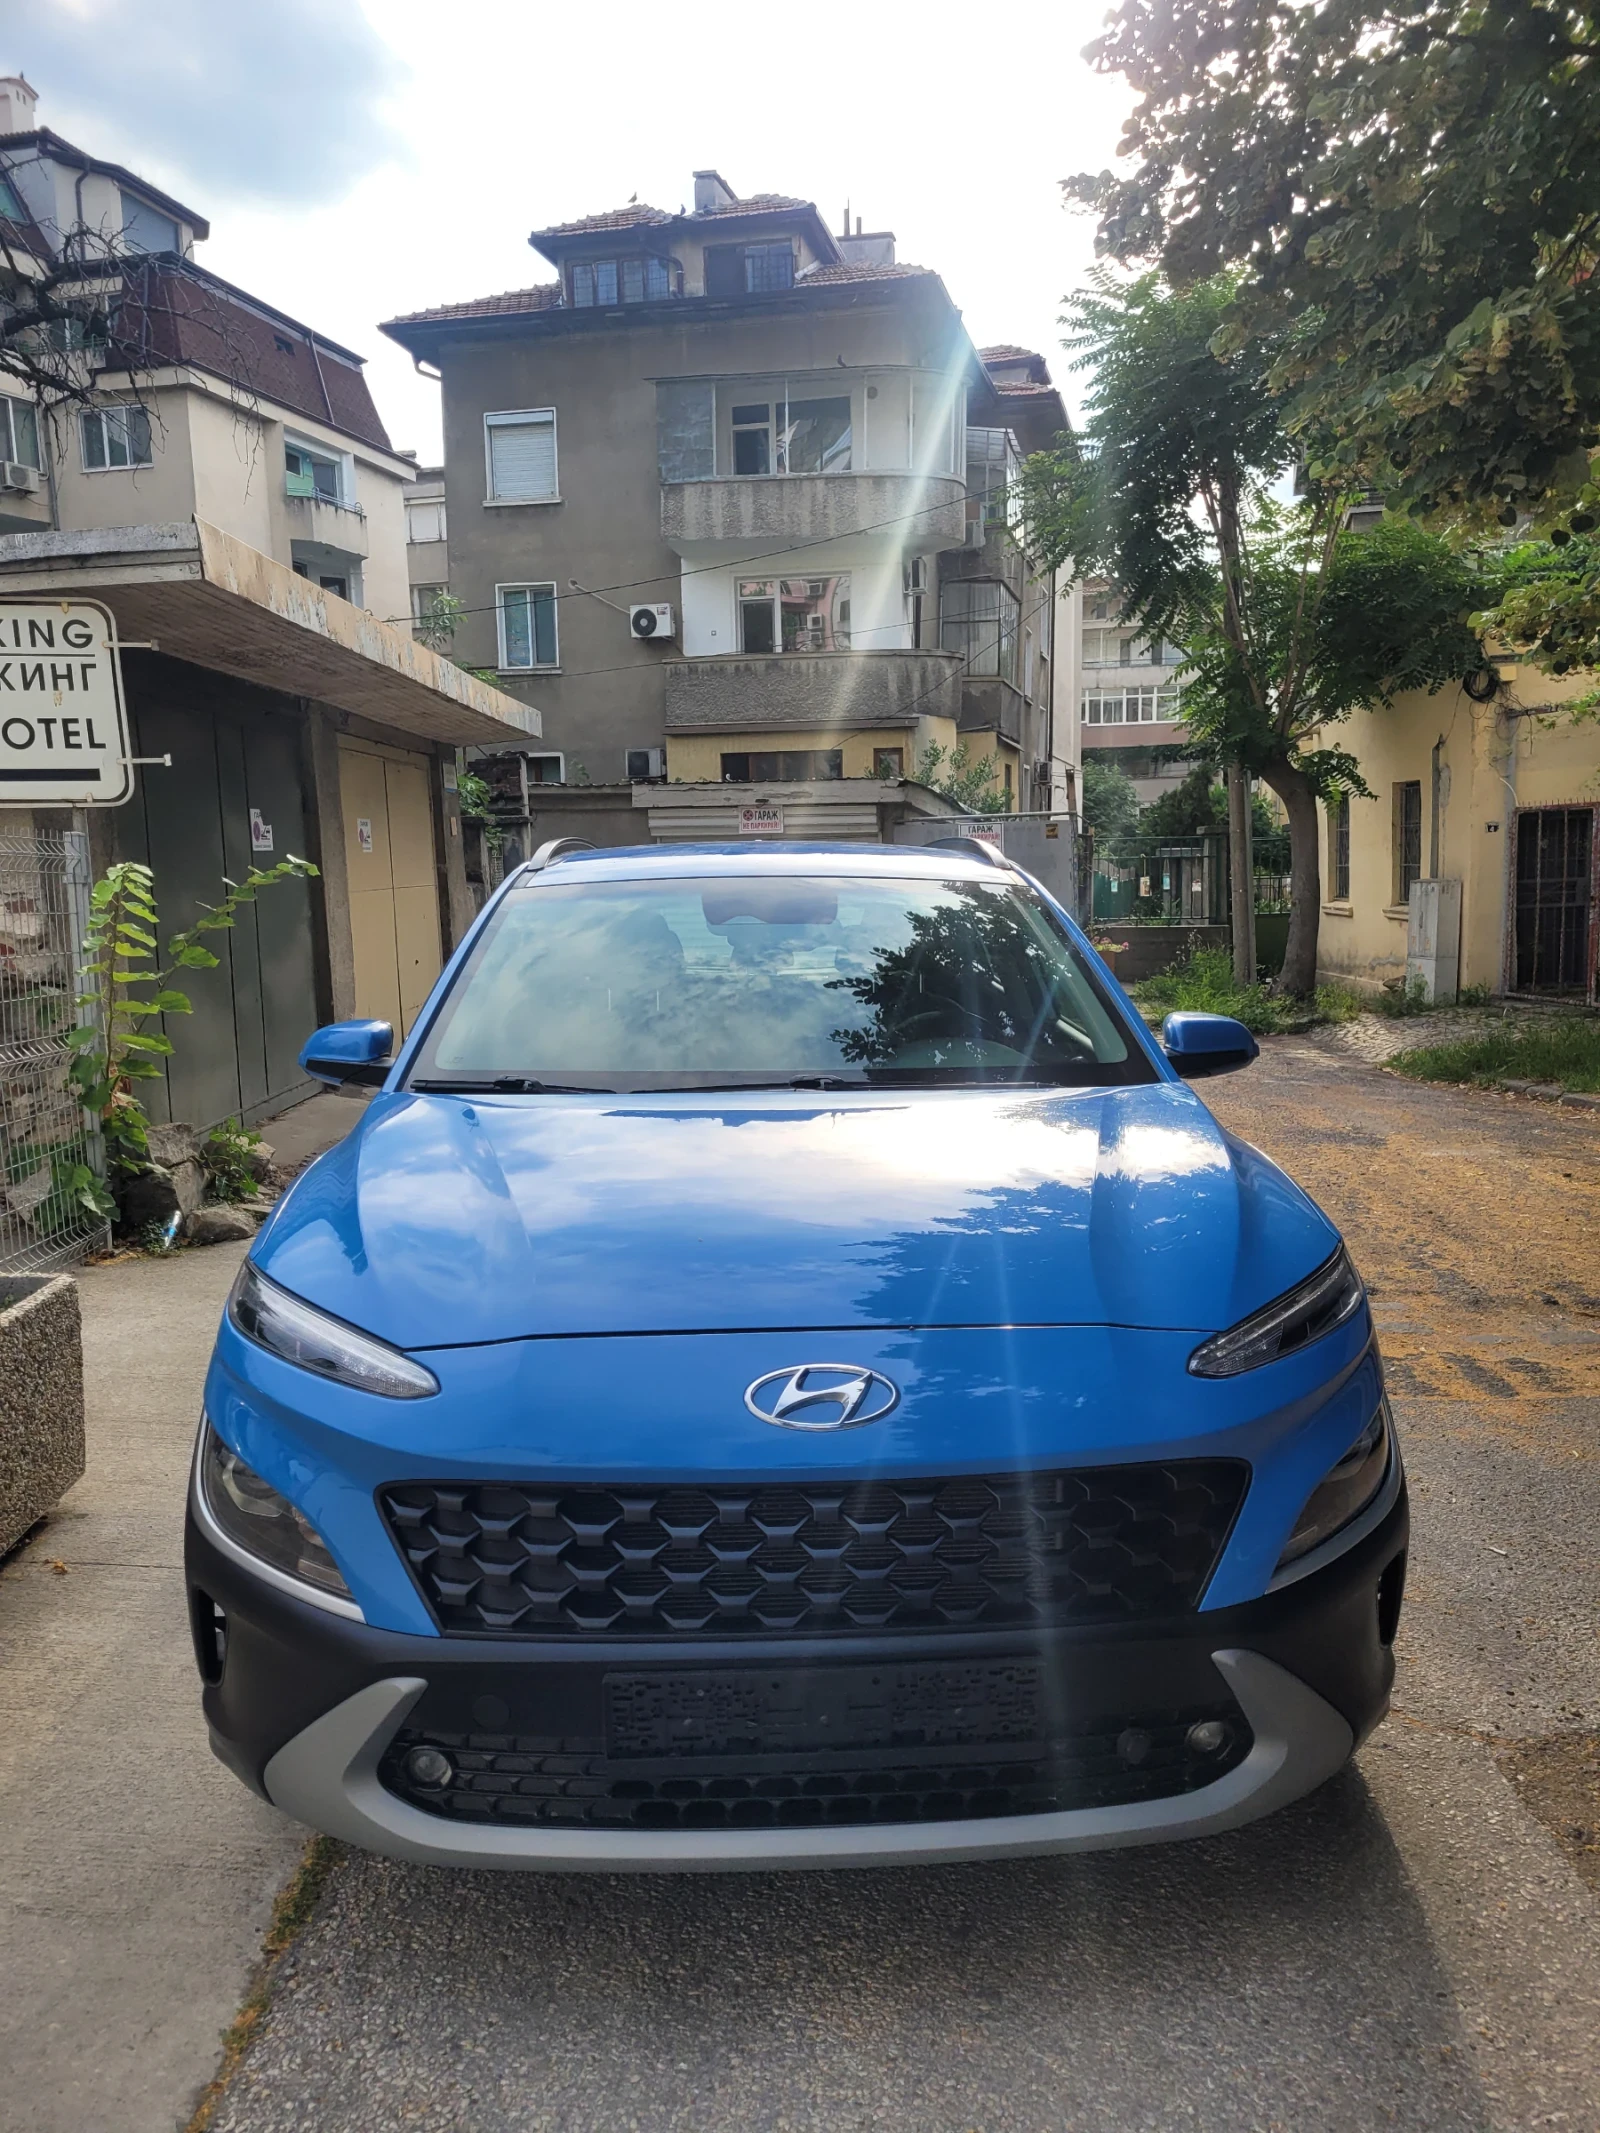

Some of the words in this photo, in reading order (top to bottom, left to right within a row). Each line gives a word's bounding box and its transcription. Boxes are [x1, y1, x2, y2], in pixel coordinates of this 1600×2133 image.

[1, 717, 107, 750] OTEL
[754, 810, 778, 820] ГАРАЖ
[751, 821, 780, 829] ПАРКИРАЙ!
[968, 825, 993, 833] ГАРАЖ
